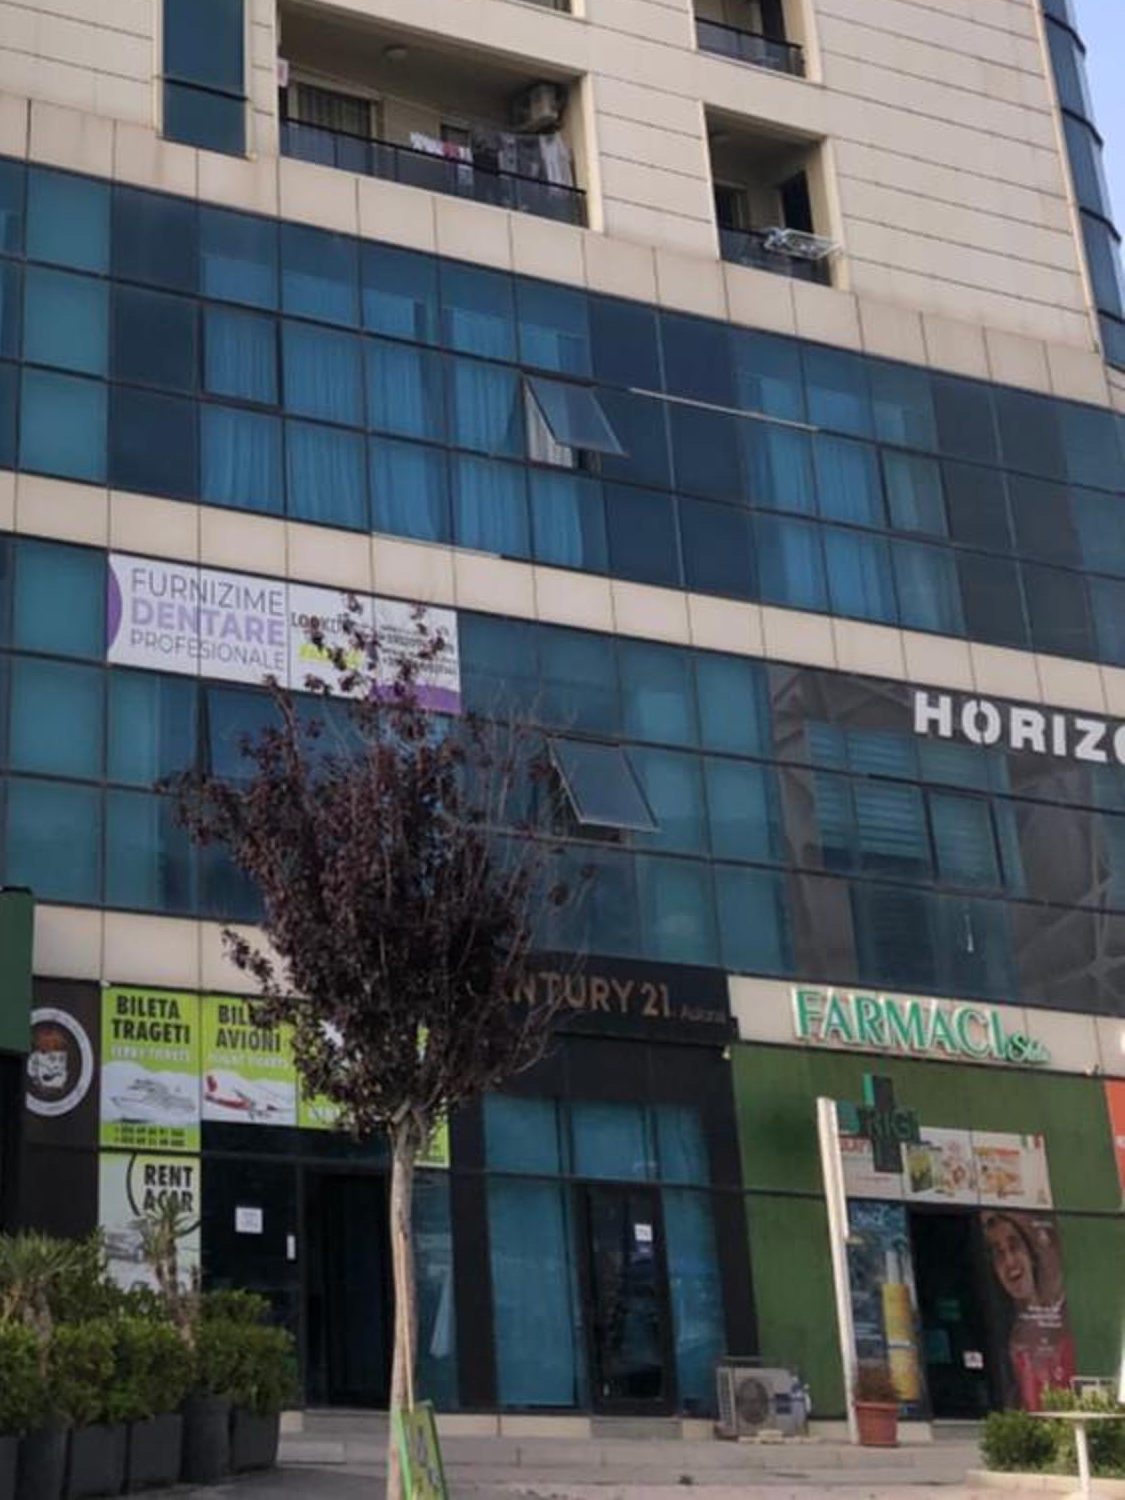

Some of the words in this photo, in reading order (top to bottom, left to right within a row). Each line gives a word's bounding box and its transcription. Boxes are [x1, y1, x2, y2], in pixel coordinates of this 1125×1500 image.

[131, 567, 284, 617] FURNIZIME
[131, 596, 284, 646] DENTARE
[131, 627, 284, 672] PROFESIONALE
[913, 690, 1125, 766] HORIZ
[117, 995, 180, 1019] BILETA
[504, 971, 635, 1013] NTURY
[639, 982, 670, 1018] 21
[112, 1019, 190, 1044] TRAGETI
[216, 1027, 280, 1052] AVIONI
[792, 986, 1007, 1060] FARMACI
[144, 1164, 193, 1188] RENT
